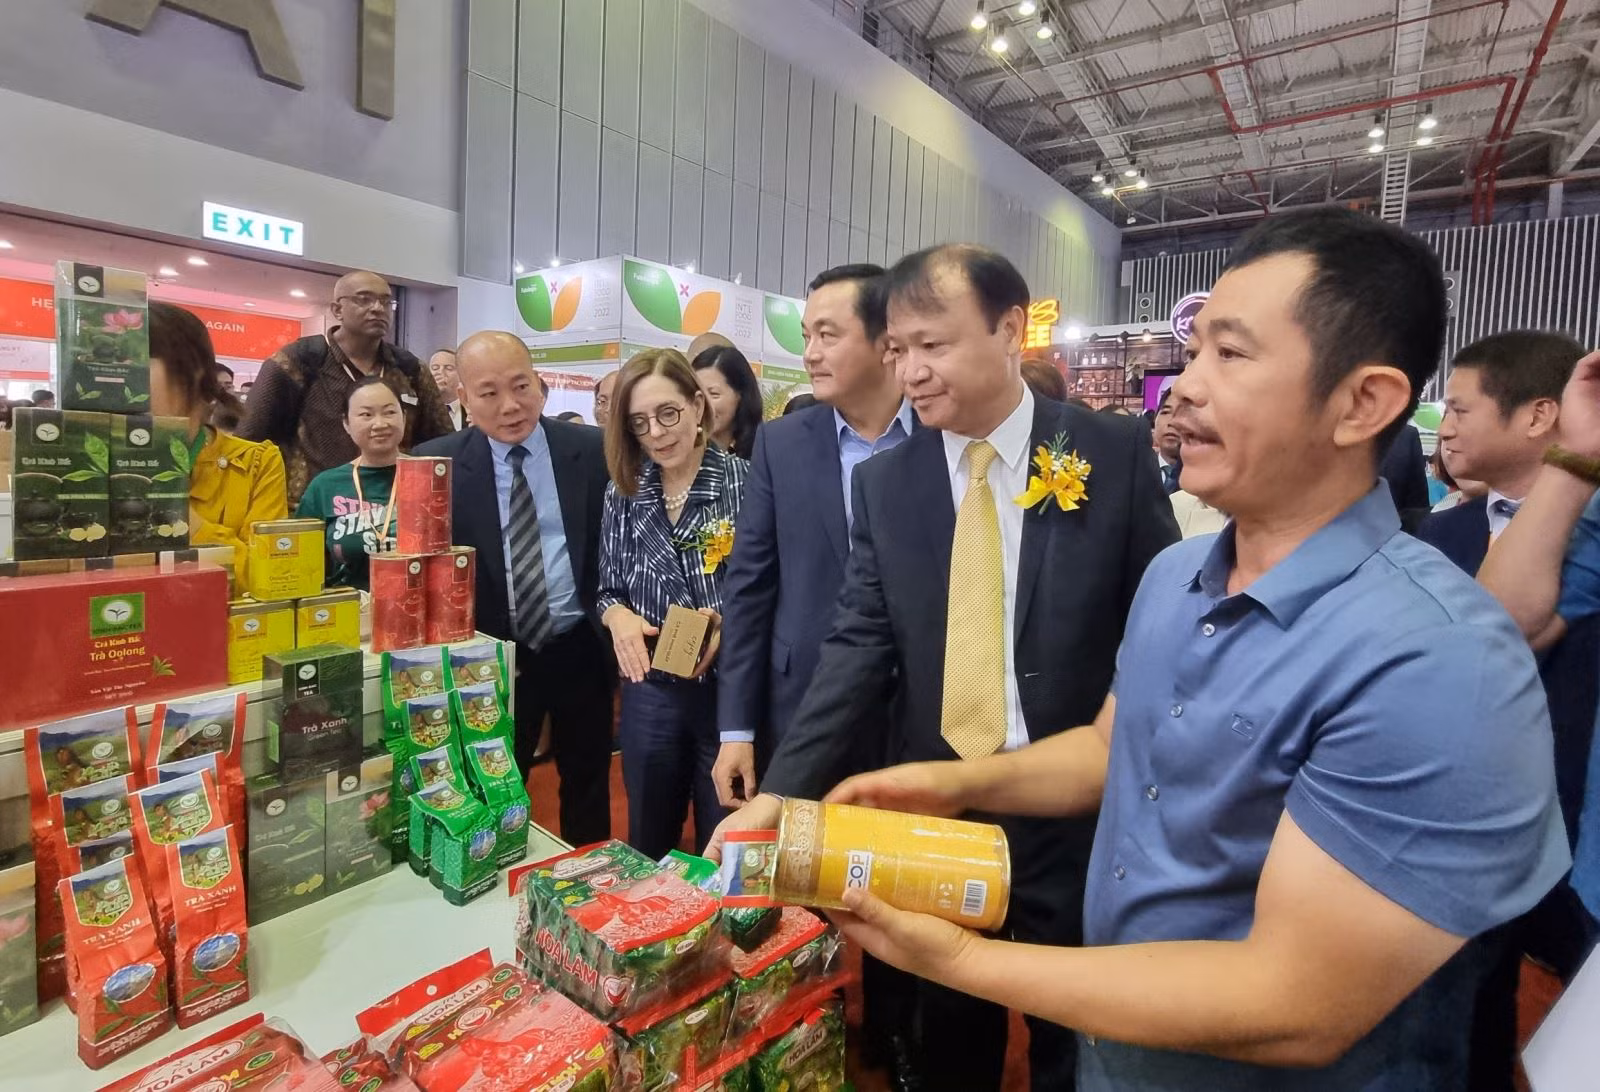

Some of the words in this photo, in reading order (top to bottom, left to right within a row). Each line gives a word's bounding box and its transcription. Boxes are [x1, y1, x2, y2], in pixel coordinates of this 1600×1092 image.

[212, 211, 294, 246] EXIT
[206, 321, 245, 333] AGAIN
[90, 651, 106, 662] Trà
[108, 646, 146, 659] Oolong
[301, 724, 318, 735] Trà
[321, 717, 348, 730] Xanh
[207, 885, 237, 898] XANH
[107, 918, 141, 936] XANH
[535, 927, 562, 965] HOA
[424, 1002, 455, 1022] HOA
